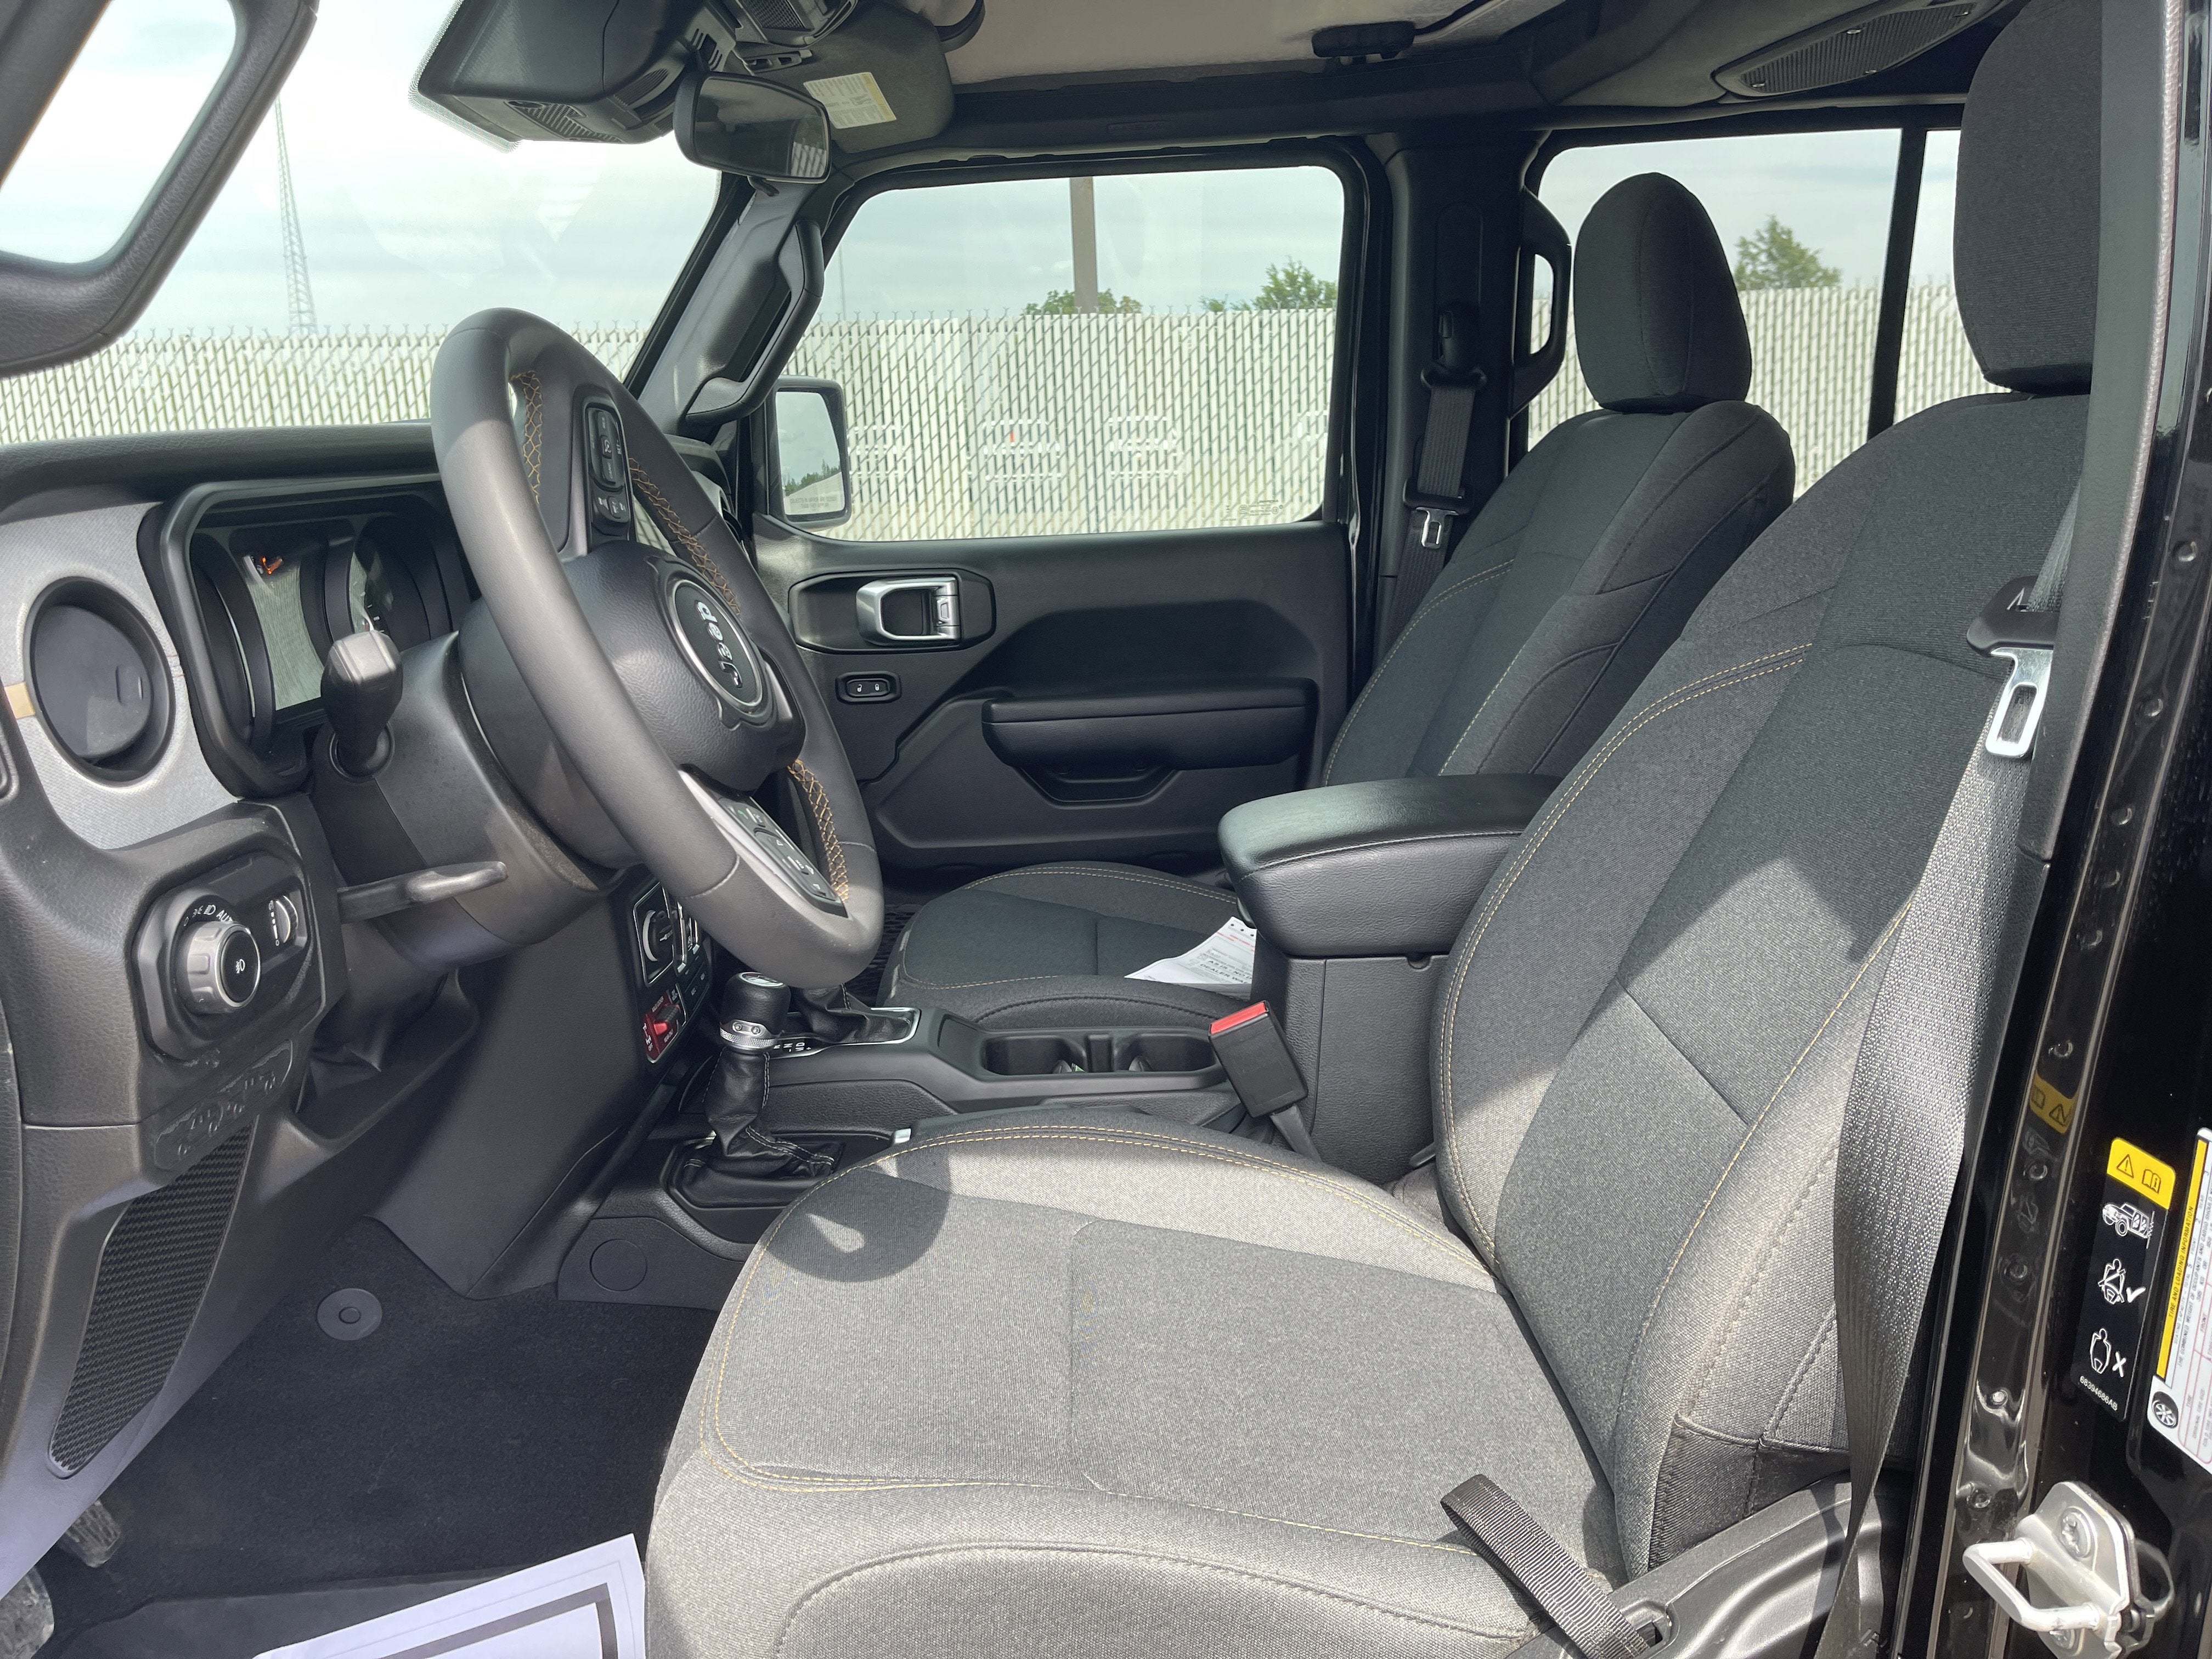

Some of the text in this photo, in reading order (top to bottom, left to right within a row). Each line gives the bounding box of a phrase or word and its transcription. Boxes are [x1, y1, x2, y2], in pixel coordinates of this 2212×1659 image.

[696, 601, 742, 688] Jeep
[216, 910, 234, 922] AUT
[2175, 1254, 2185, 1286] LOADING
[2181, 1206, 2193, 1254] INFORMATION
[2185, 1300, 2193, 1324] WEIGHT
[2191, 1255, 2202, 1292] OCCUPANTS
[2200, 1220, 2208, 1242] CARGO
